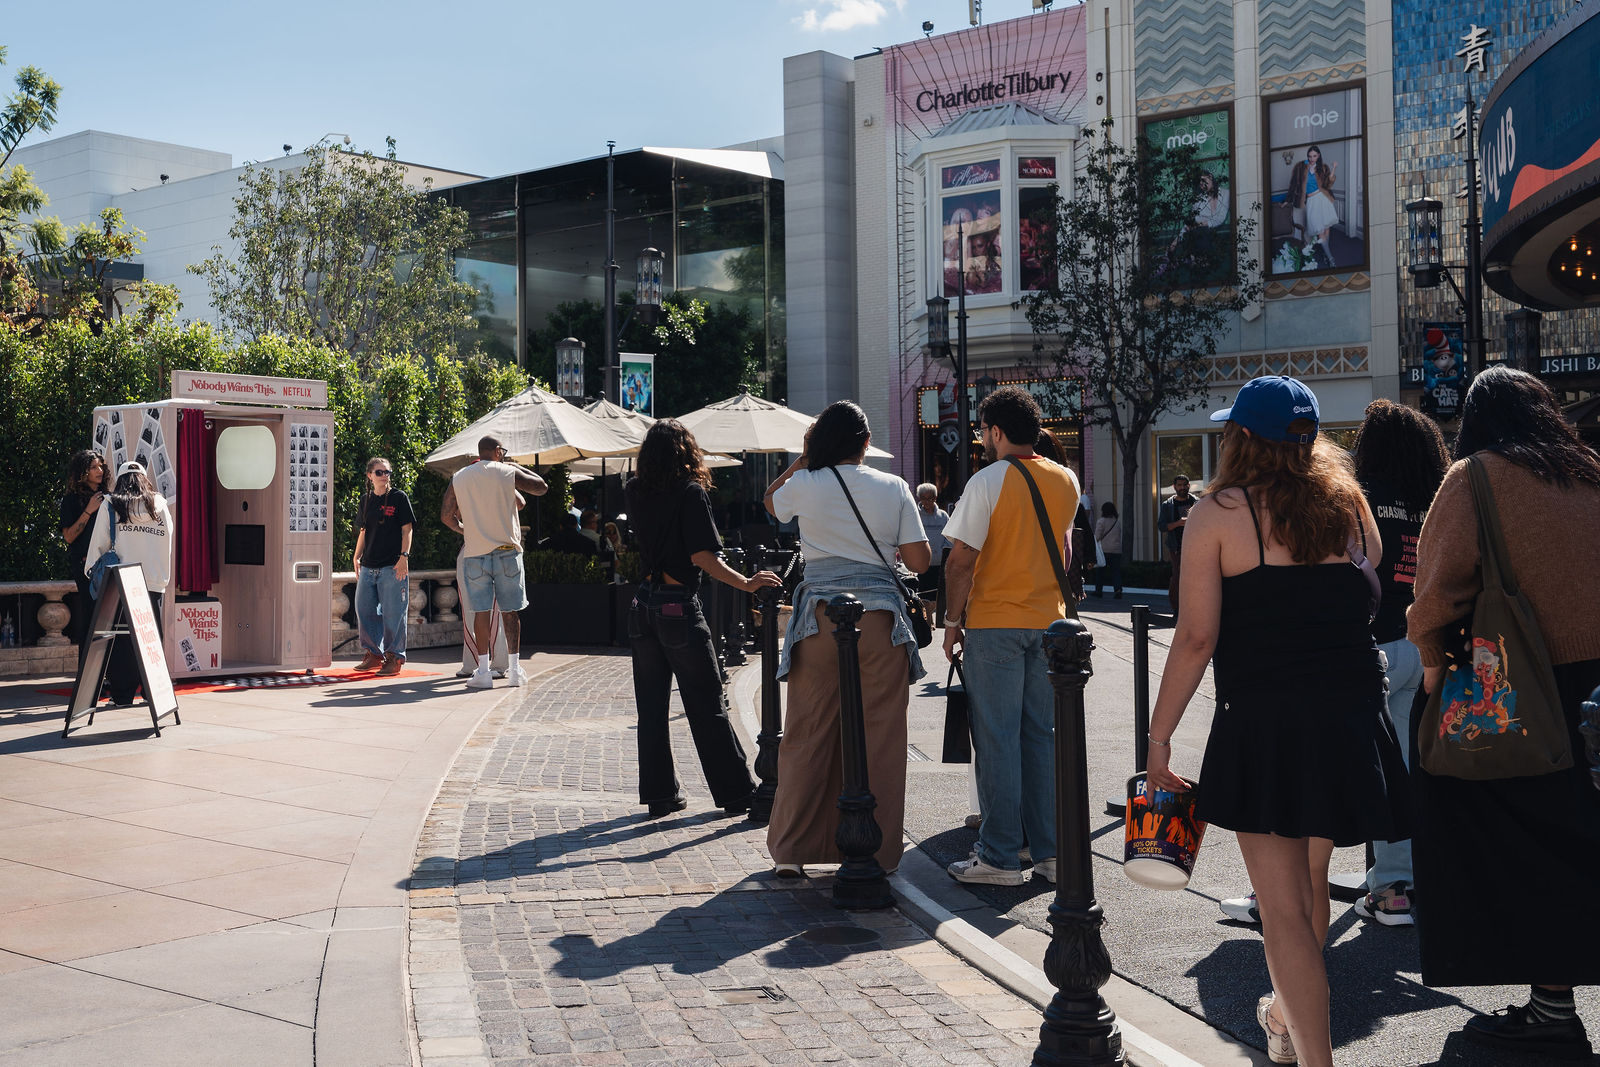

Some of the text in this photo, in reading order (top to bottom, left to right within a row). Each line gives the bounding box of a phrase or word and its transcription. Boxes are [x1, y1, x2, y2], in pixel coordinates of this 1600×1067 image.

[1294, 108, 1339, 128] maje
[1166, 130, 1208, 149] maje
[188, 380, 312, 398] Nobody Wants This. NETFLIX
[1432, 388, 1452, 398] CAT
[1438, 396, 1458, 406] HAT
[1377, 505, 1408, 520] CHASING
[133, 526, 165, 536] ANGELES
[177, 608, 218, 621] Nobody
[188, 618, 218, 628] Wants
[193, 628, 218, 641] This.
[211, 653, 218, 668] N
